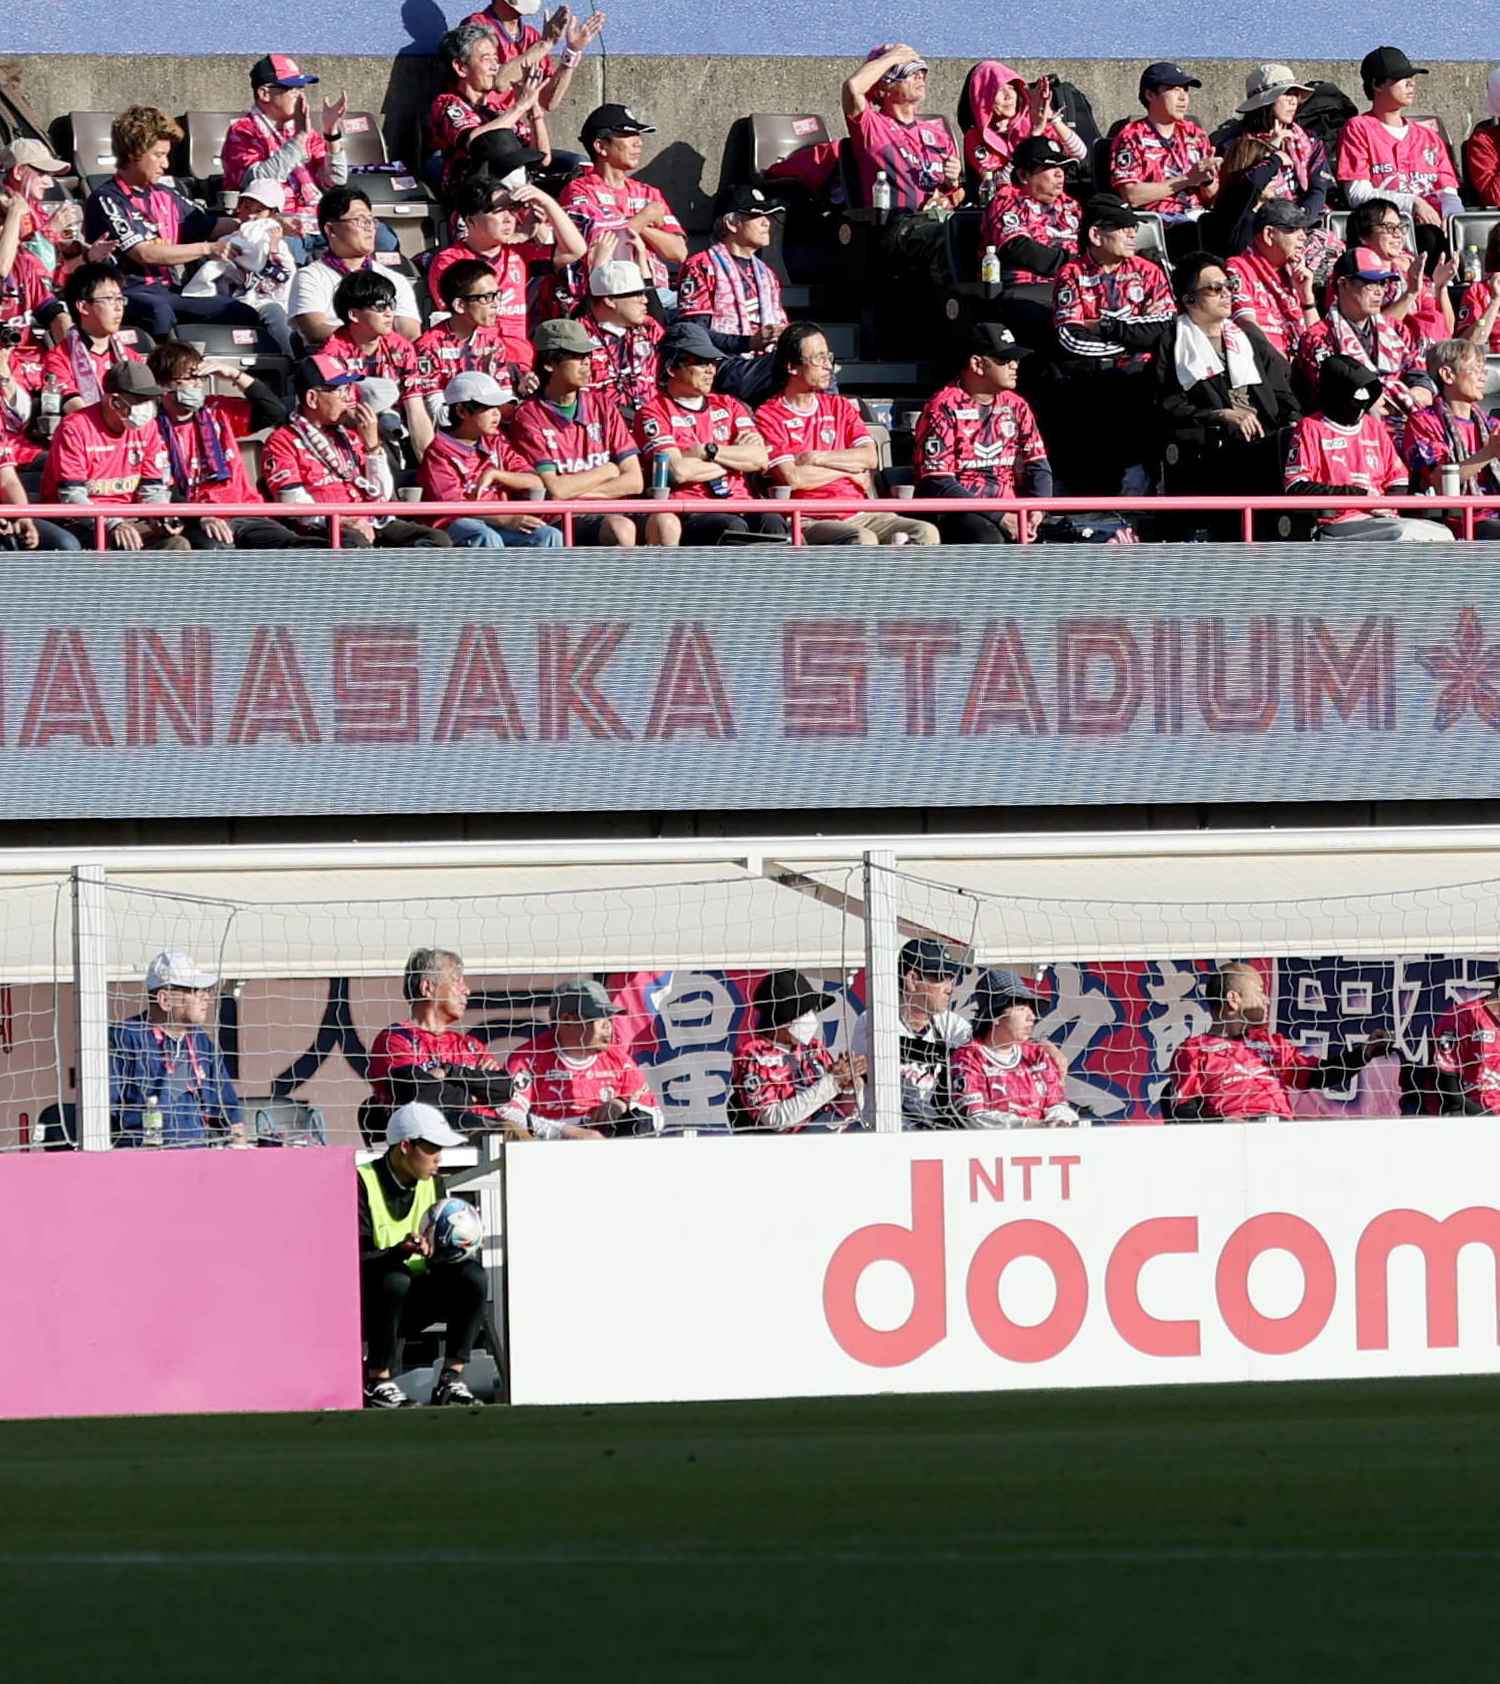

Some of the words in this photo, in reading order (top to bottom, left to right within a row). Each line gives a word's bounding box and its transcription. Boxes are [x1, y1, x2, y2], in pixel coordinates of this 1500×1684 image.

[556, 450, 611, 475] HARP
[780, 614, 1396, 738] STADIUM
[968, 1154, 1082, 1203] NTT
